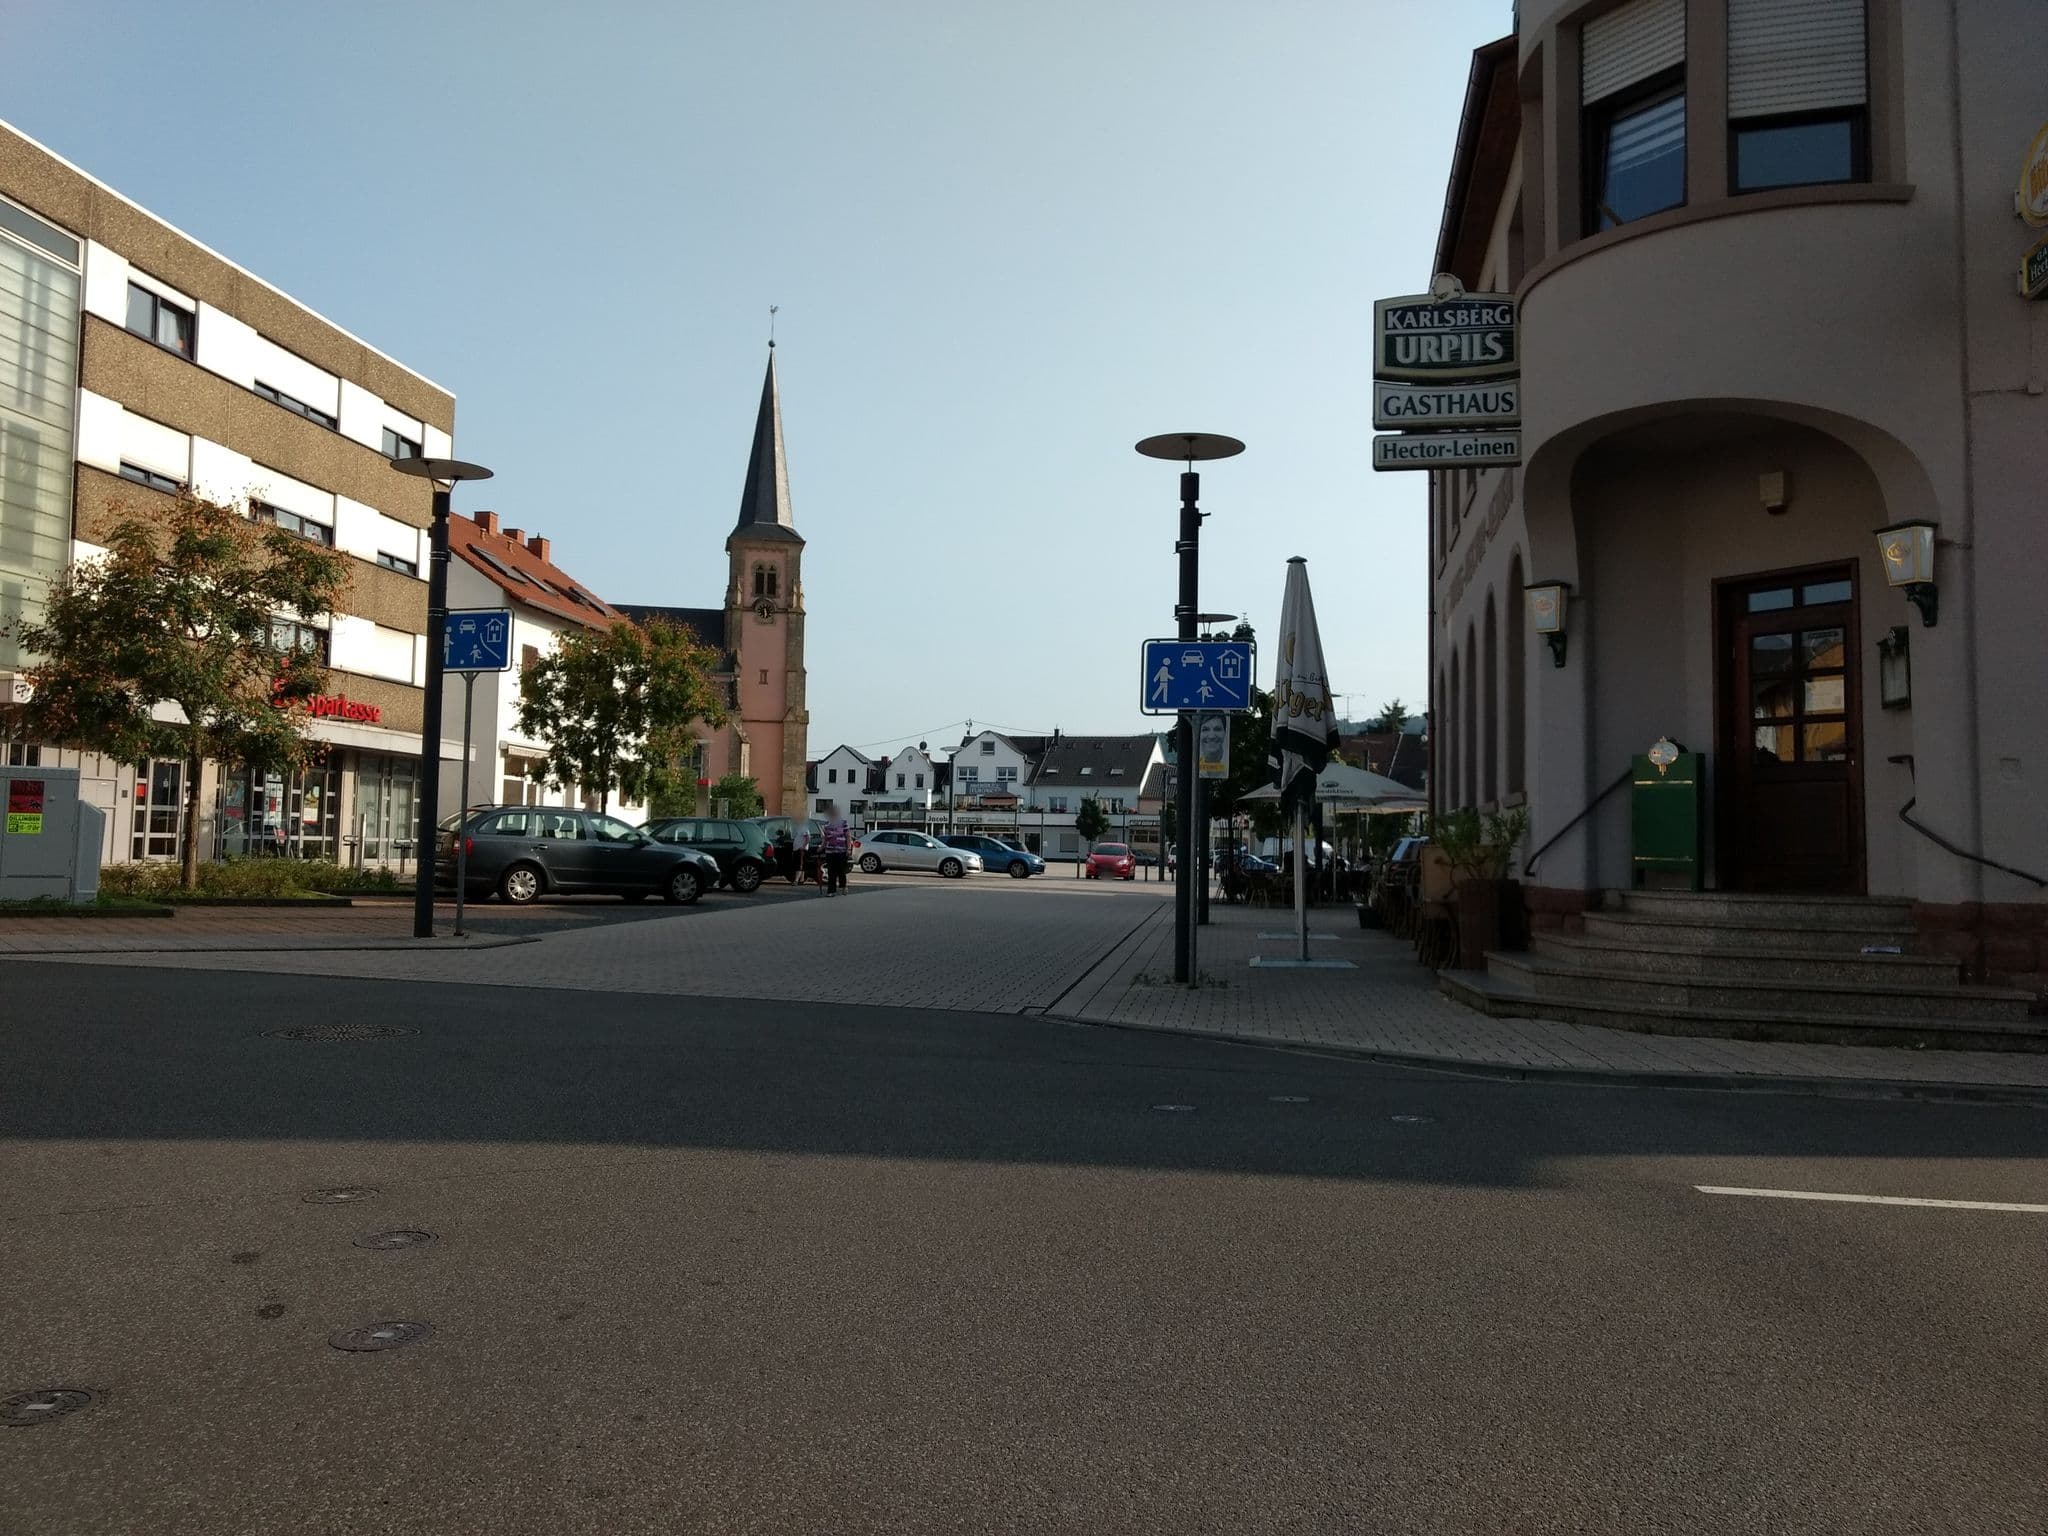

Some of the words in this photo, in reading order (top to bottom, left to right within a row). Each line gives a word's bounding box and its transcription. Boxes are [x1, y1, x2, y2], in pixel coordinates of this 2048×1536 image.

[1387, 305, 1512, 329] KARLSBERG
[1395, 331, 1504, 364] URPILS
[1383, 392, 1514, 417] GASTHAUS
[1383, 438, 1515, 459] Hector-Leinen
[306, 691, 381, 724] Sparkasse
